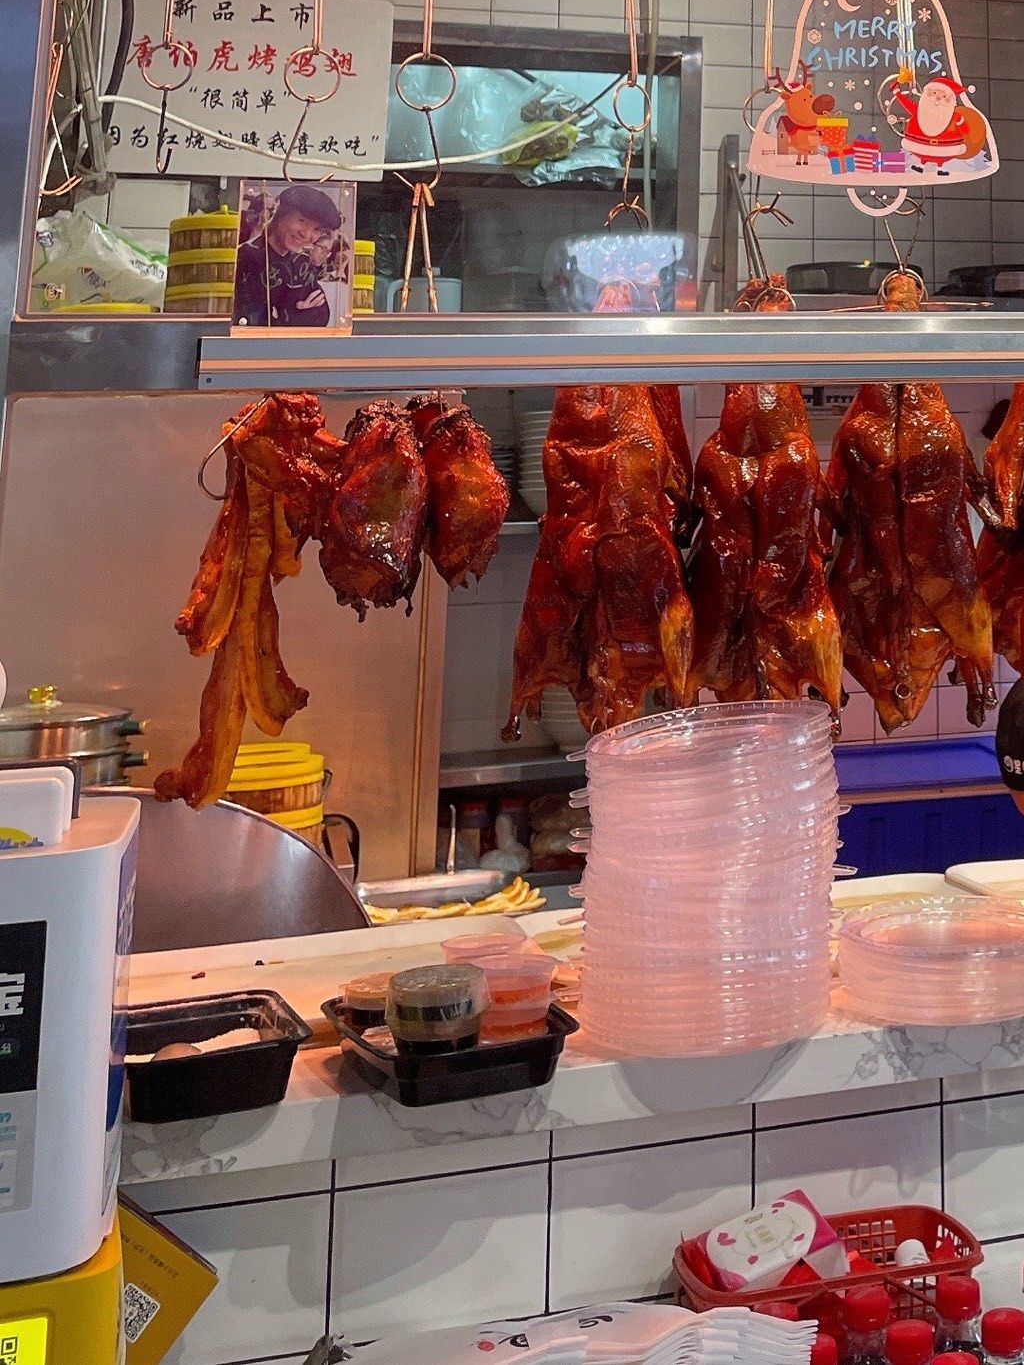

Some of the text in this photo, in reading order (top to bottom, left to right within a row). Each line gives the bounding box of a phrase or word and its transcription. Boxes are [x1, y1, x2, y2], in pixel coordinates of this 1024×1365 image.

[833, 15, 916, 41] MERRY
[125, 35, 357, 78] 唐伯虎烤鸡翅
[805, 45, 944, 75] CHRISTMAS
